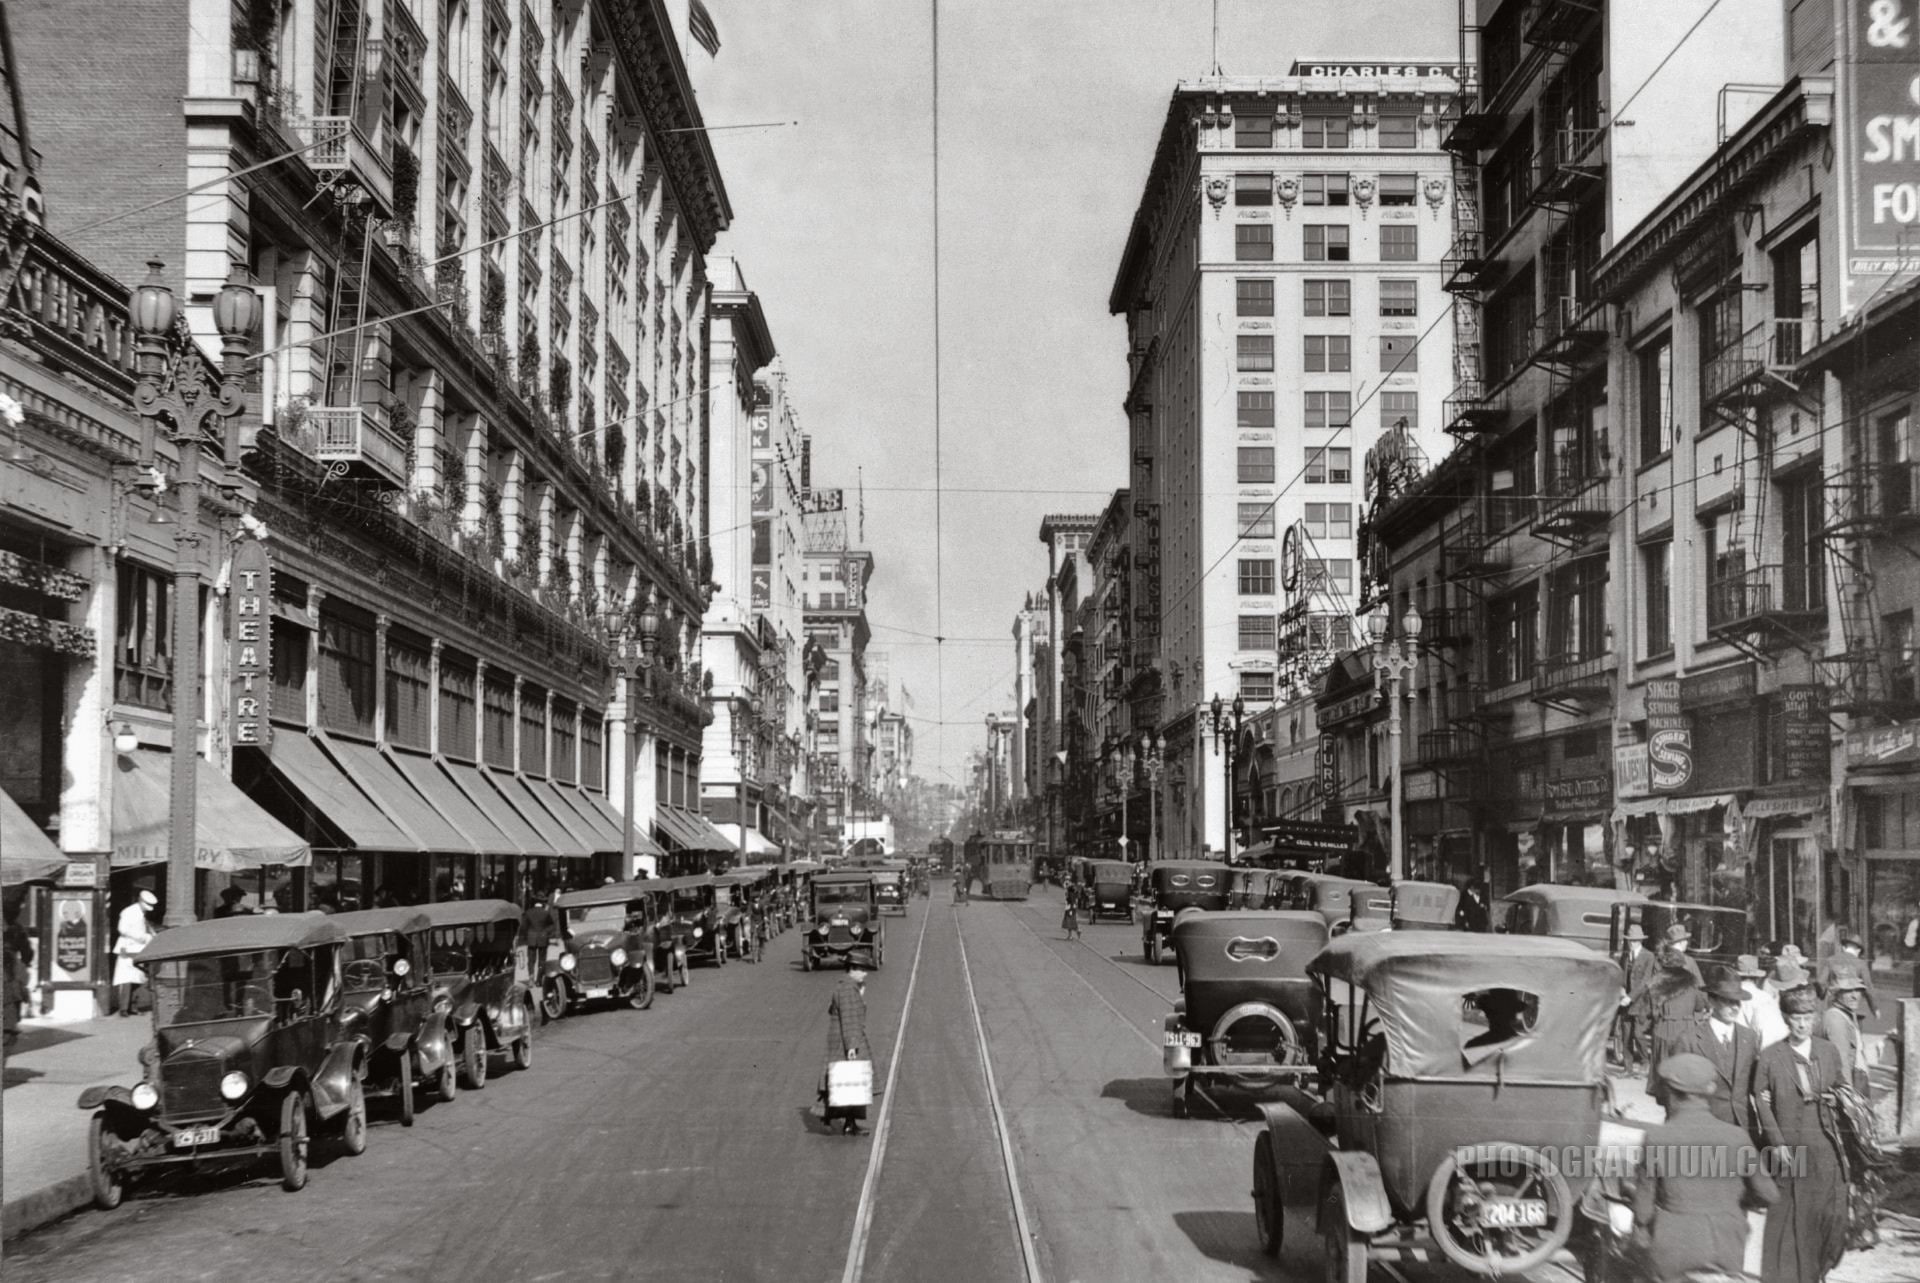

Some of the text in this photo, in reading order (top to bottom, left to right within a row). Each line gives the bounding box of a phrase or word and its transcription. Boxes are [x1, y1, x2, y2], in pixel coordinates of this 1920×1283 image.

[1310, 66, 1418, 78] CHARLES
[1149, 506, 1160, 634] MOROSCO
[237, 570, 261, 743] THEATRE
[1647, 682, 1680, 699] SINGER
[1648, 702, 1679, 714] SEWING
[1655, 732, 1686, 746] SINGER
[1658, 750, 1686, 765] SEWING
[1323, 739, 1334, 794] FURS
[116, 845, 221, 864] MILLRY
